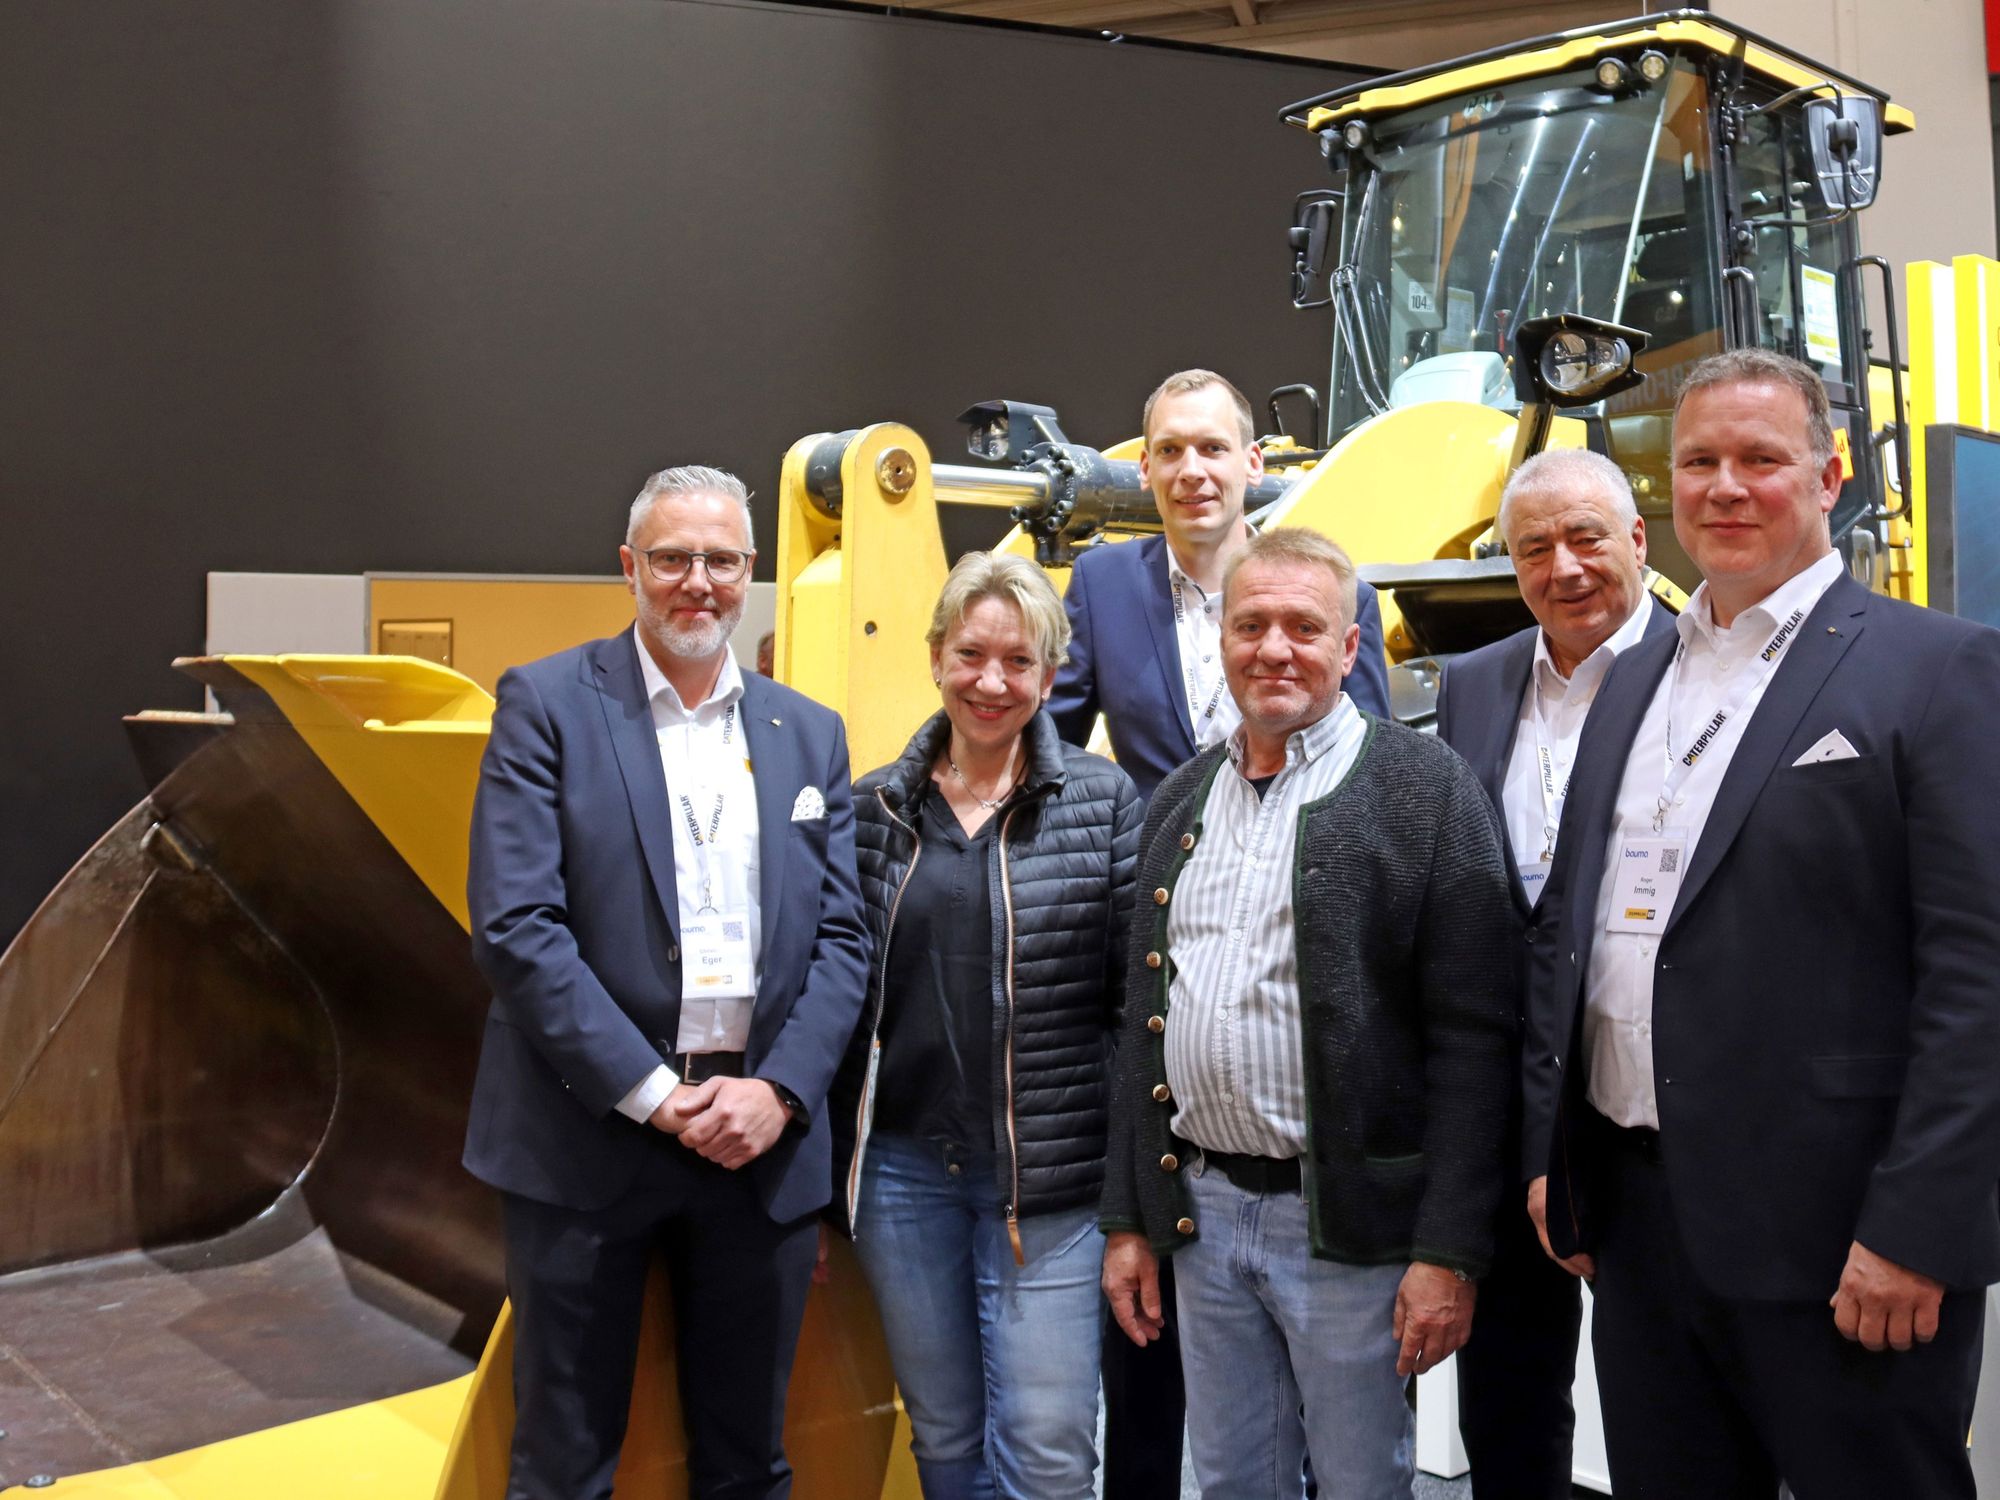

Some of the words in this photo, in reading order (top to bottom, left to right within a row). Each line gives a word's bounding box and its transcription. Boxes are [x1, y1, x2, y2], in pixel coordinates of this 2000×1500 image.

[1411, 295, 1427, 310] 104
[1174, 583, 1184, 624] CATERPILLAR
[1761, 609, 1804, 662] CATERPILLAR
[1186, 668, 1199, 711] CATERPILLAR
[1205, 675, 1226, 719] CATERPILLAR
[1682, 710, 1727, 767] CATERPILLAR
[1541, 747, 1554, 795] CATERPILLAR
[680, 795, 704, 846] CATERPILLAR
[708, 794, 724, 843] CATERPILLAR
[1625, 848, 1649, 858] bauma
[1634, 885, 1656, 896] Immig
[702, 956, 722, 965] Eger
